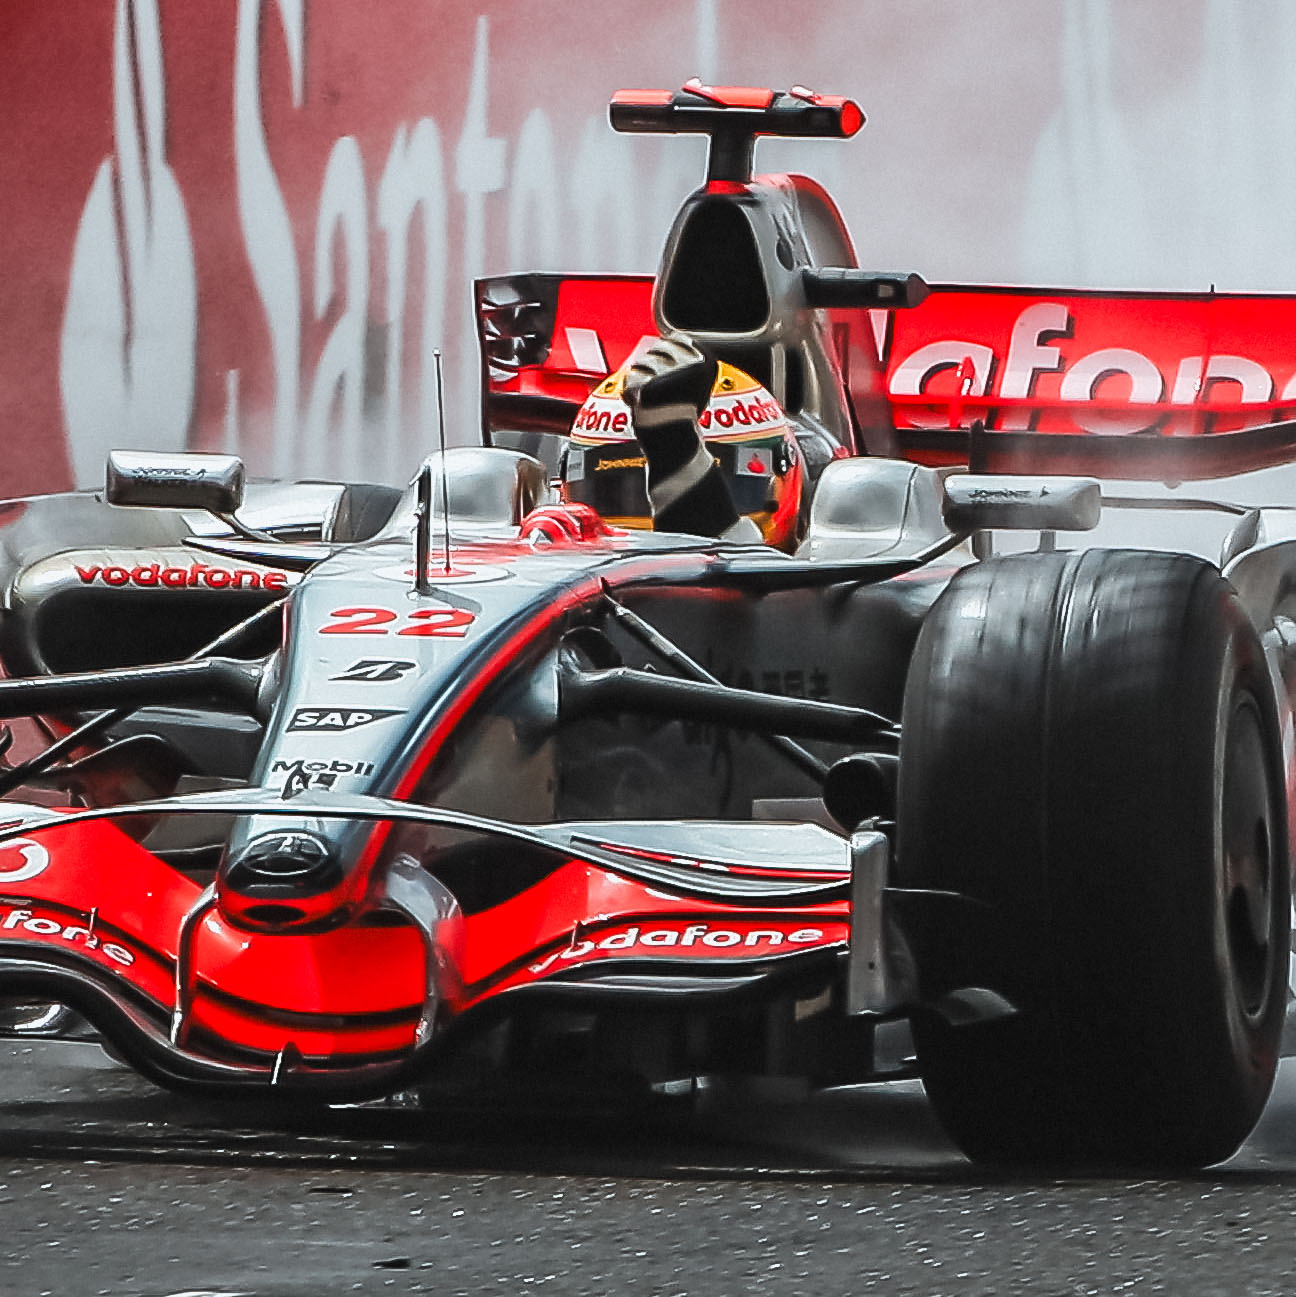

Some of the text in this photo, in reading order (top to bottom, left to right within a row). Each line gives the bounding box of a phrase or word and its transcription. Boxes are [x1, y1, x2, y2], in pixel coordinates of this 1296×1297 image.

[74, 562, 289, 590] vodafone
[318, 607, 476, 638] 22
[293, 711, 373, 727] SAP
[527, 923, 824, 974] vodafone
